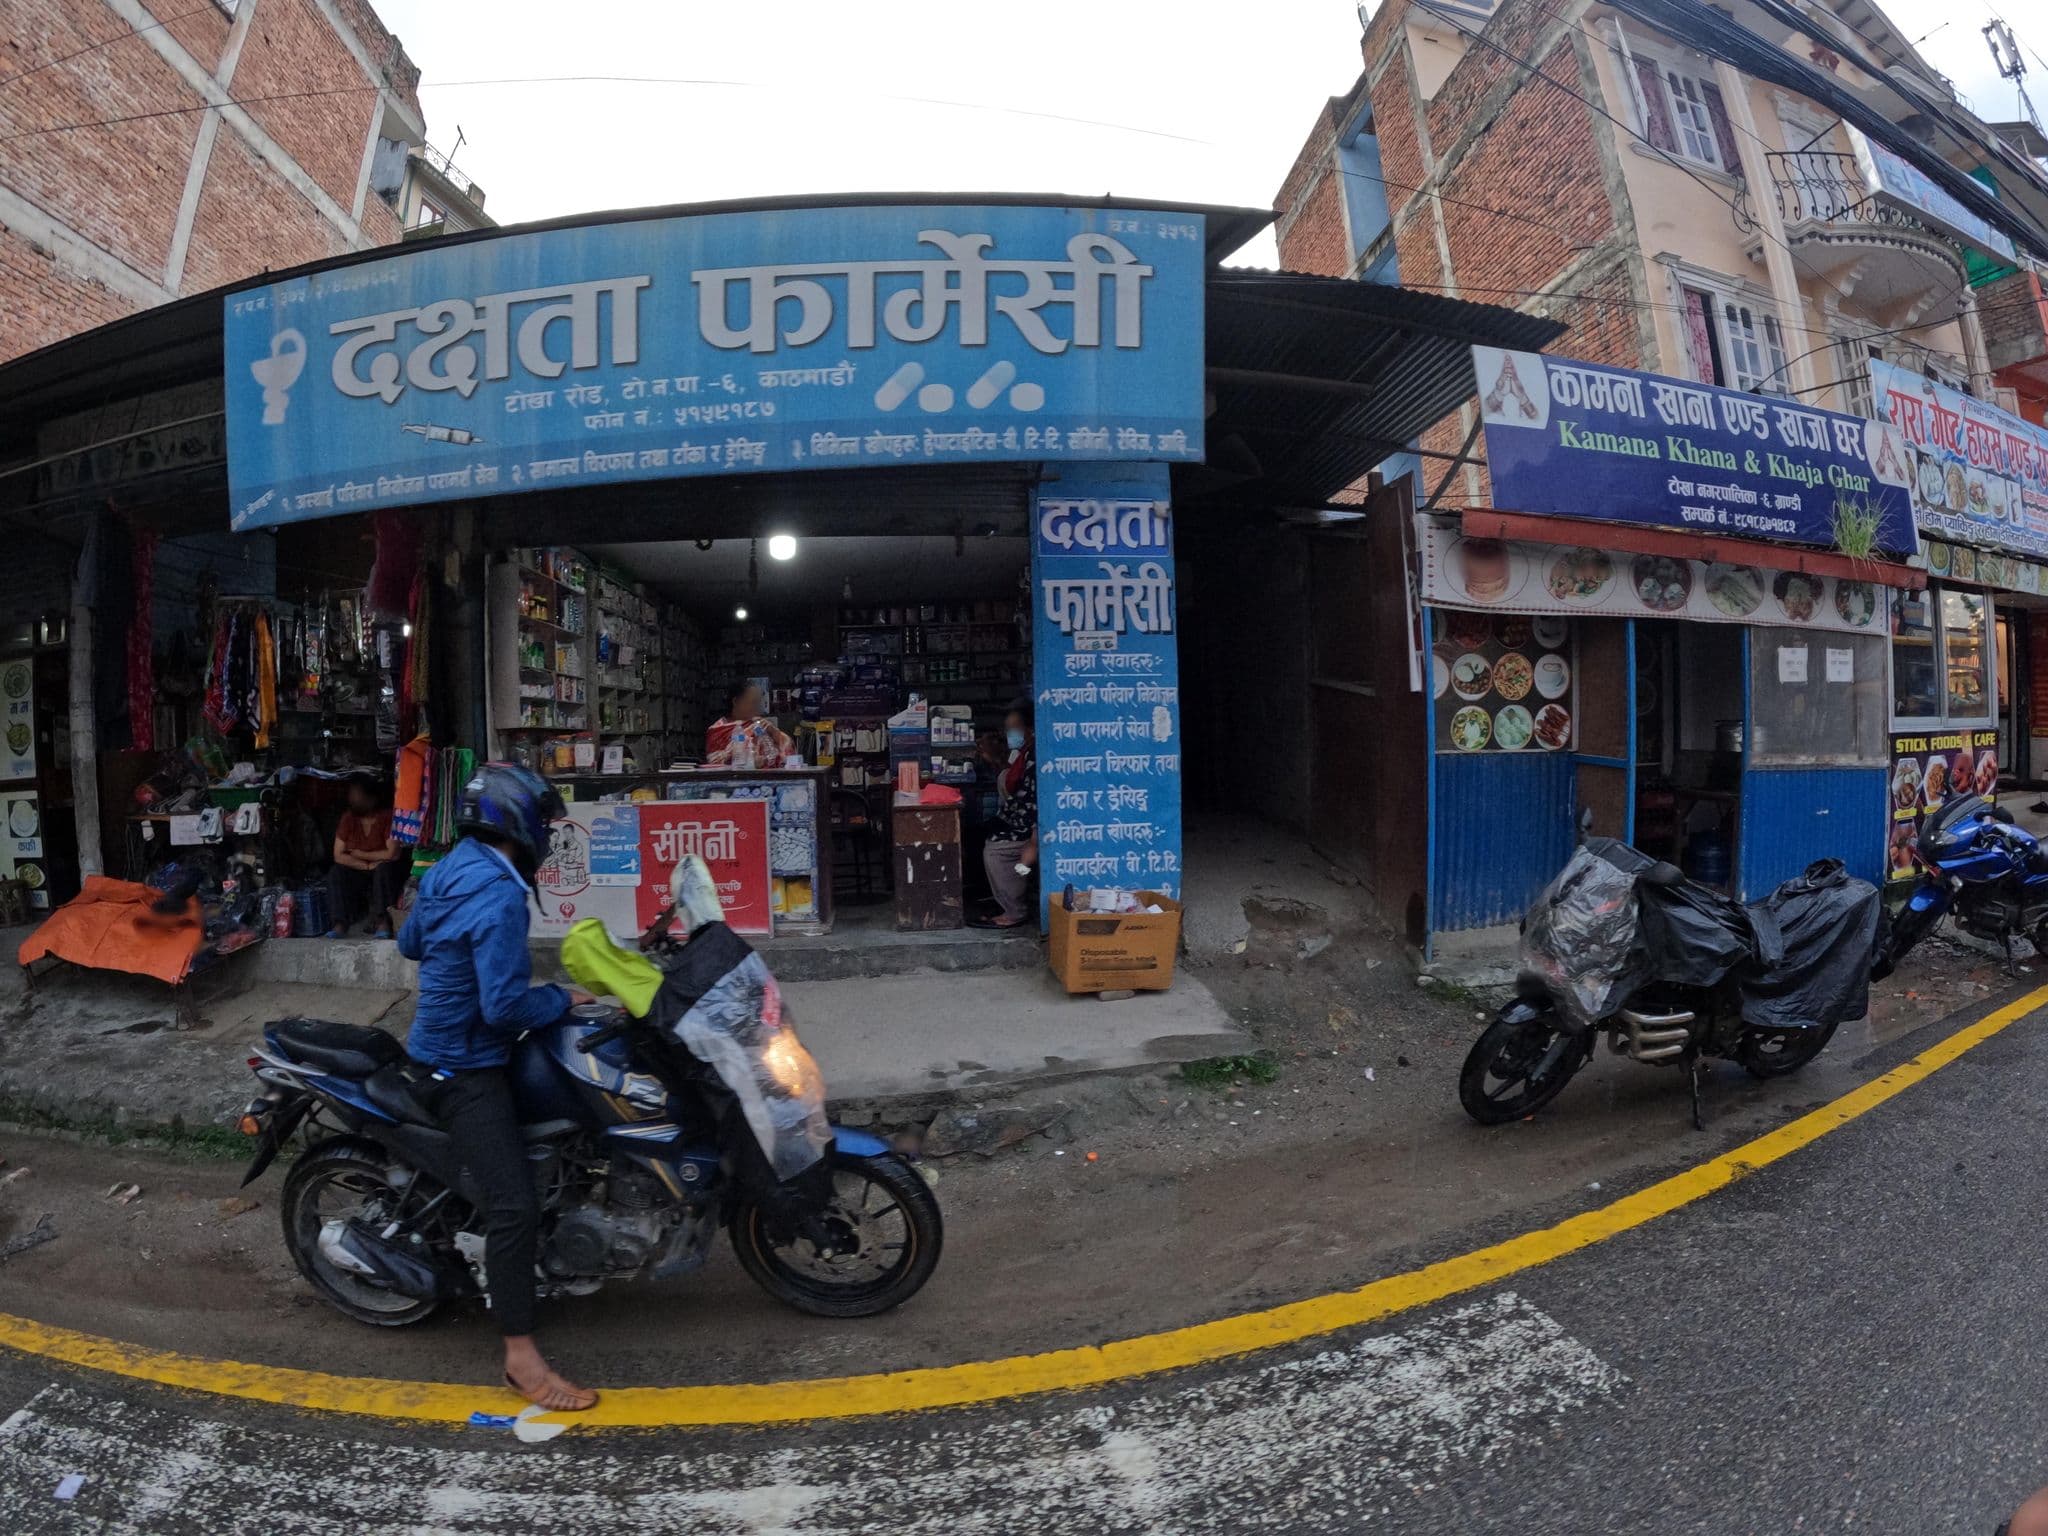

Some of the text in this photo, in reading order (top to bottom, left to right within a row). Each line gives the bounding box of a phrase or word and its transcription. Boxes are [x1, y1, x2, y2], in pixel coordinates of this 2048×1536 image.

[330, 229, 1153, 404] दक्षता फार्मेसी
[504, 390, 555, 413] टोखा
[564, 384, 610, 408] रोड,
[758, 360, 858, 390] काठमाडौं
[584, 409, 625, 431] फोन
[1547, 364, 1866, 461] कामना खाना एण्ड खाजा घर
[1887, 389, 1927, 446] रारा
[1964, 418, 2003, 475] हाउस
[2005, 433, 2033, 481] एण्ड
[529, 456, 580, 479] सामान्य
[583, 449, 635, 473] चिरफार
[639, 448, 669, 468] तथा
[672, 441, 707, 465] टाँका
[710, 444, 722, 462] र
[1559, 420, 1870, 493] Kamana Khana & Khaja Ghar
[336, 480, 375, 503] परिवार
[377, 474, 425, 498] नियोजन
[427, 464, 473, 490] परामर्श
[475, 462, 500, 485] सेवा
[1668, 475, 1695, 497] टोखा
[1697, 483, 1758, 505] नगरपालिका
[1774, 493, 1802, 512] ग्राण्डी
[1680, 505, 1716, 523] सम्पर्क
[1040, 501, 1172, 633] दक्षता फार्मेसी
[1051, 682, 1178, 710] अस्थायी परिवार नियोजन
[1053, 715, 1150, 742] तथा परामर्श सेवा
[1896, 738, 1928, 753] STICK
[1930, 735, 1963, 751] FOODS
[1974, 733, 1996, 747] CAFE
[1055, 750, 1179, 778] सामान्य चिरफार तथा
[1056, 784, 1088, 810] टाँका
[1093, 790, 1103, 810] र
[651, 820, 738, 862] संगिनी
[1057, 820, 1104, 844] विभिन्न
[651, 883, 668, 895] एक
